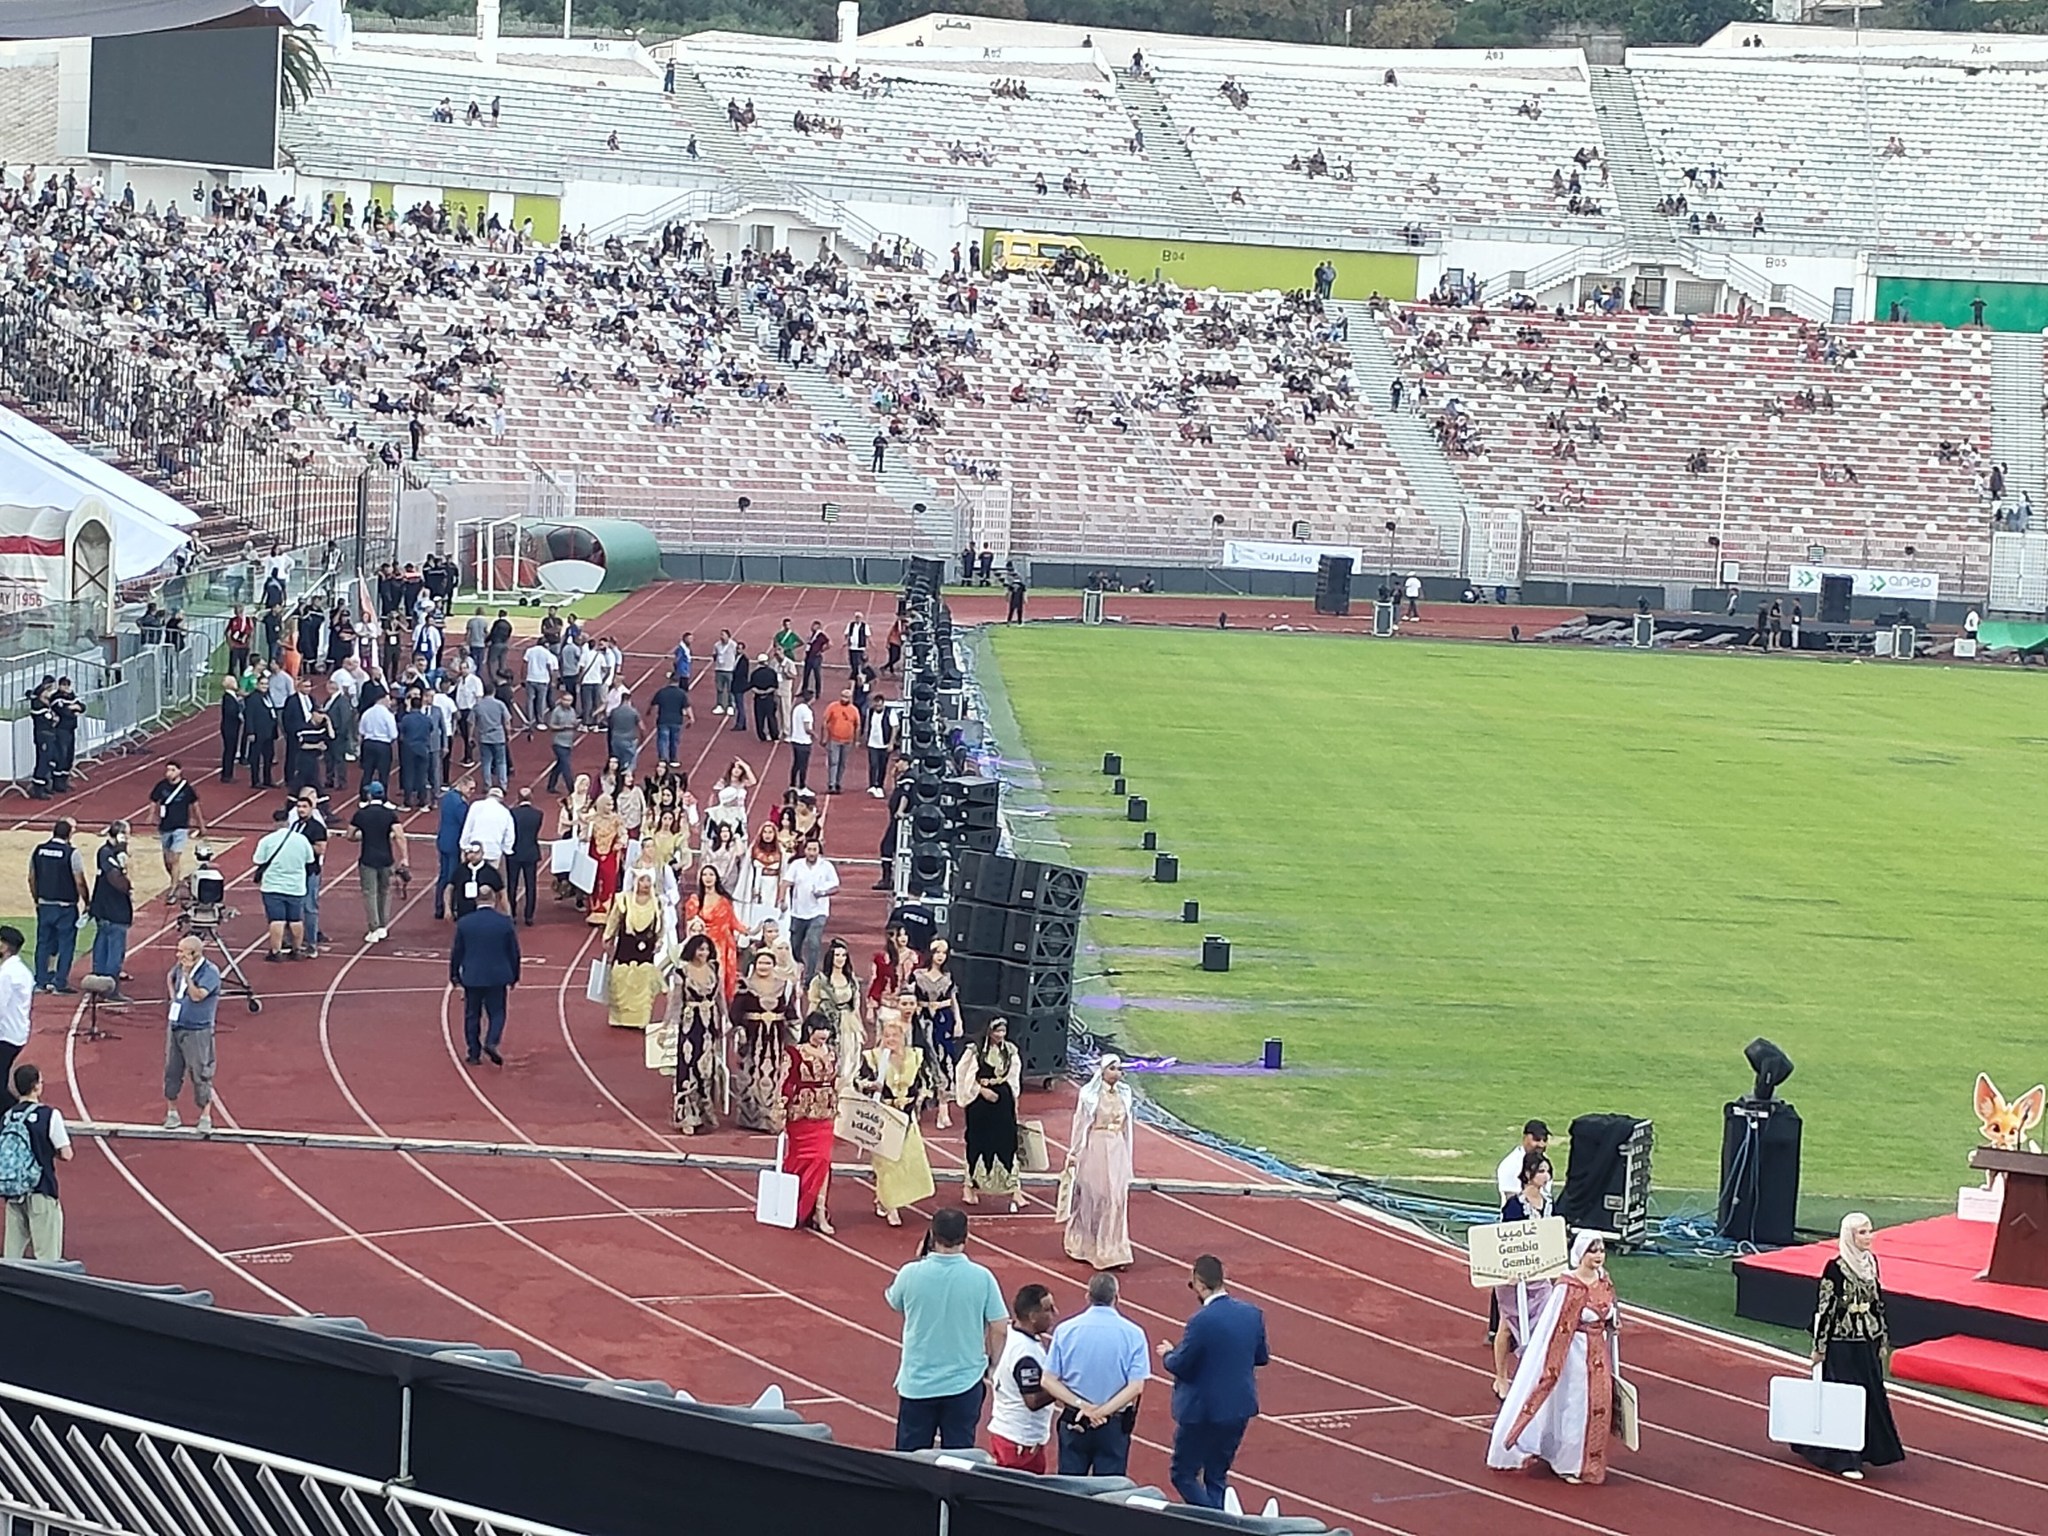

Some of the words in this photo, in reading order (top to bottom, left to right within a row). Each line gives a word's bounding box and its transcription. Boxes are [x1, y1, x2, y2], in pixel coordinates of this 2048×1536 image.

[1162, 249, 1185, 261] B04
[1765, 257, 1787, 268] B05
[1888, 575, 1932, 588] anep
[1496, 1222, 1538, 1242] غامبيا
[1498, 1240, 1539, 1255] Gambia
[1502, 1254, 1541, 1269] Gambie
